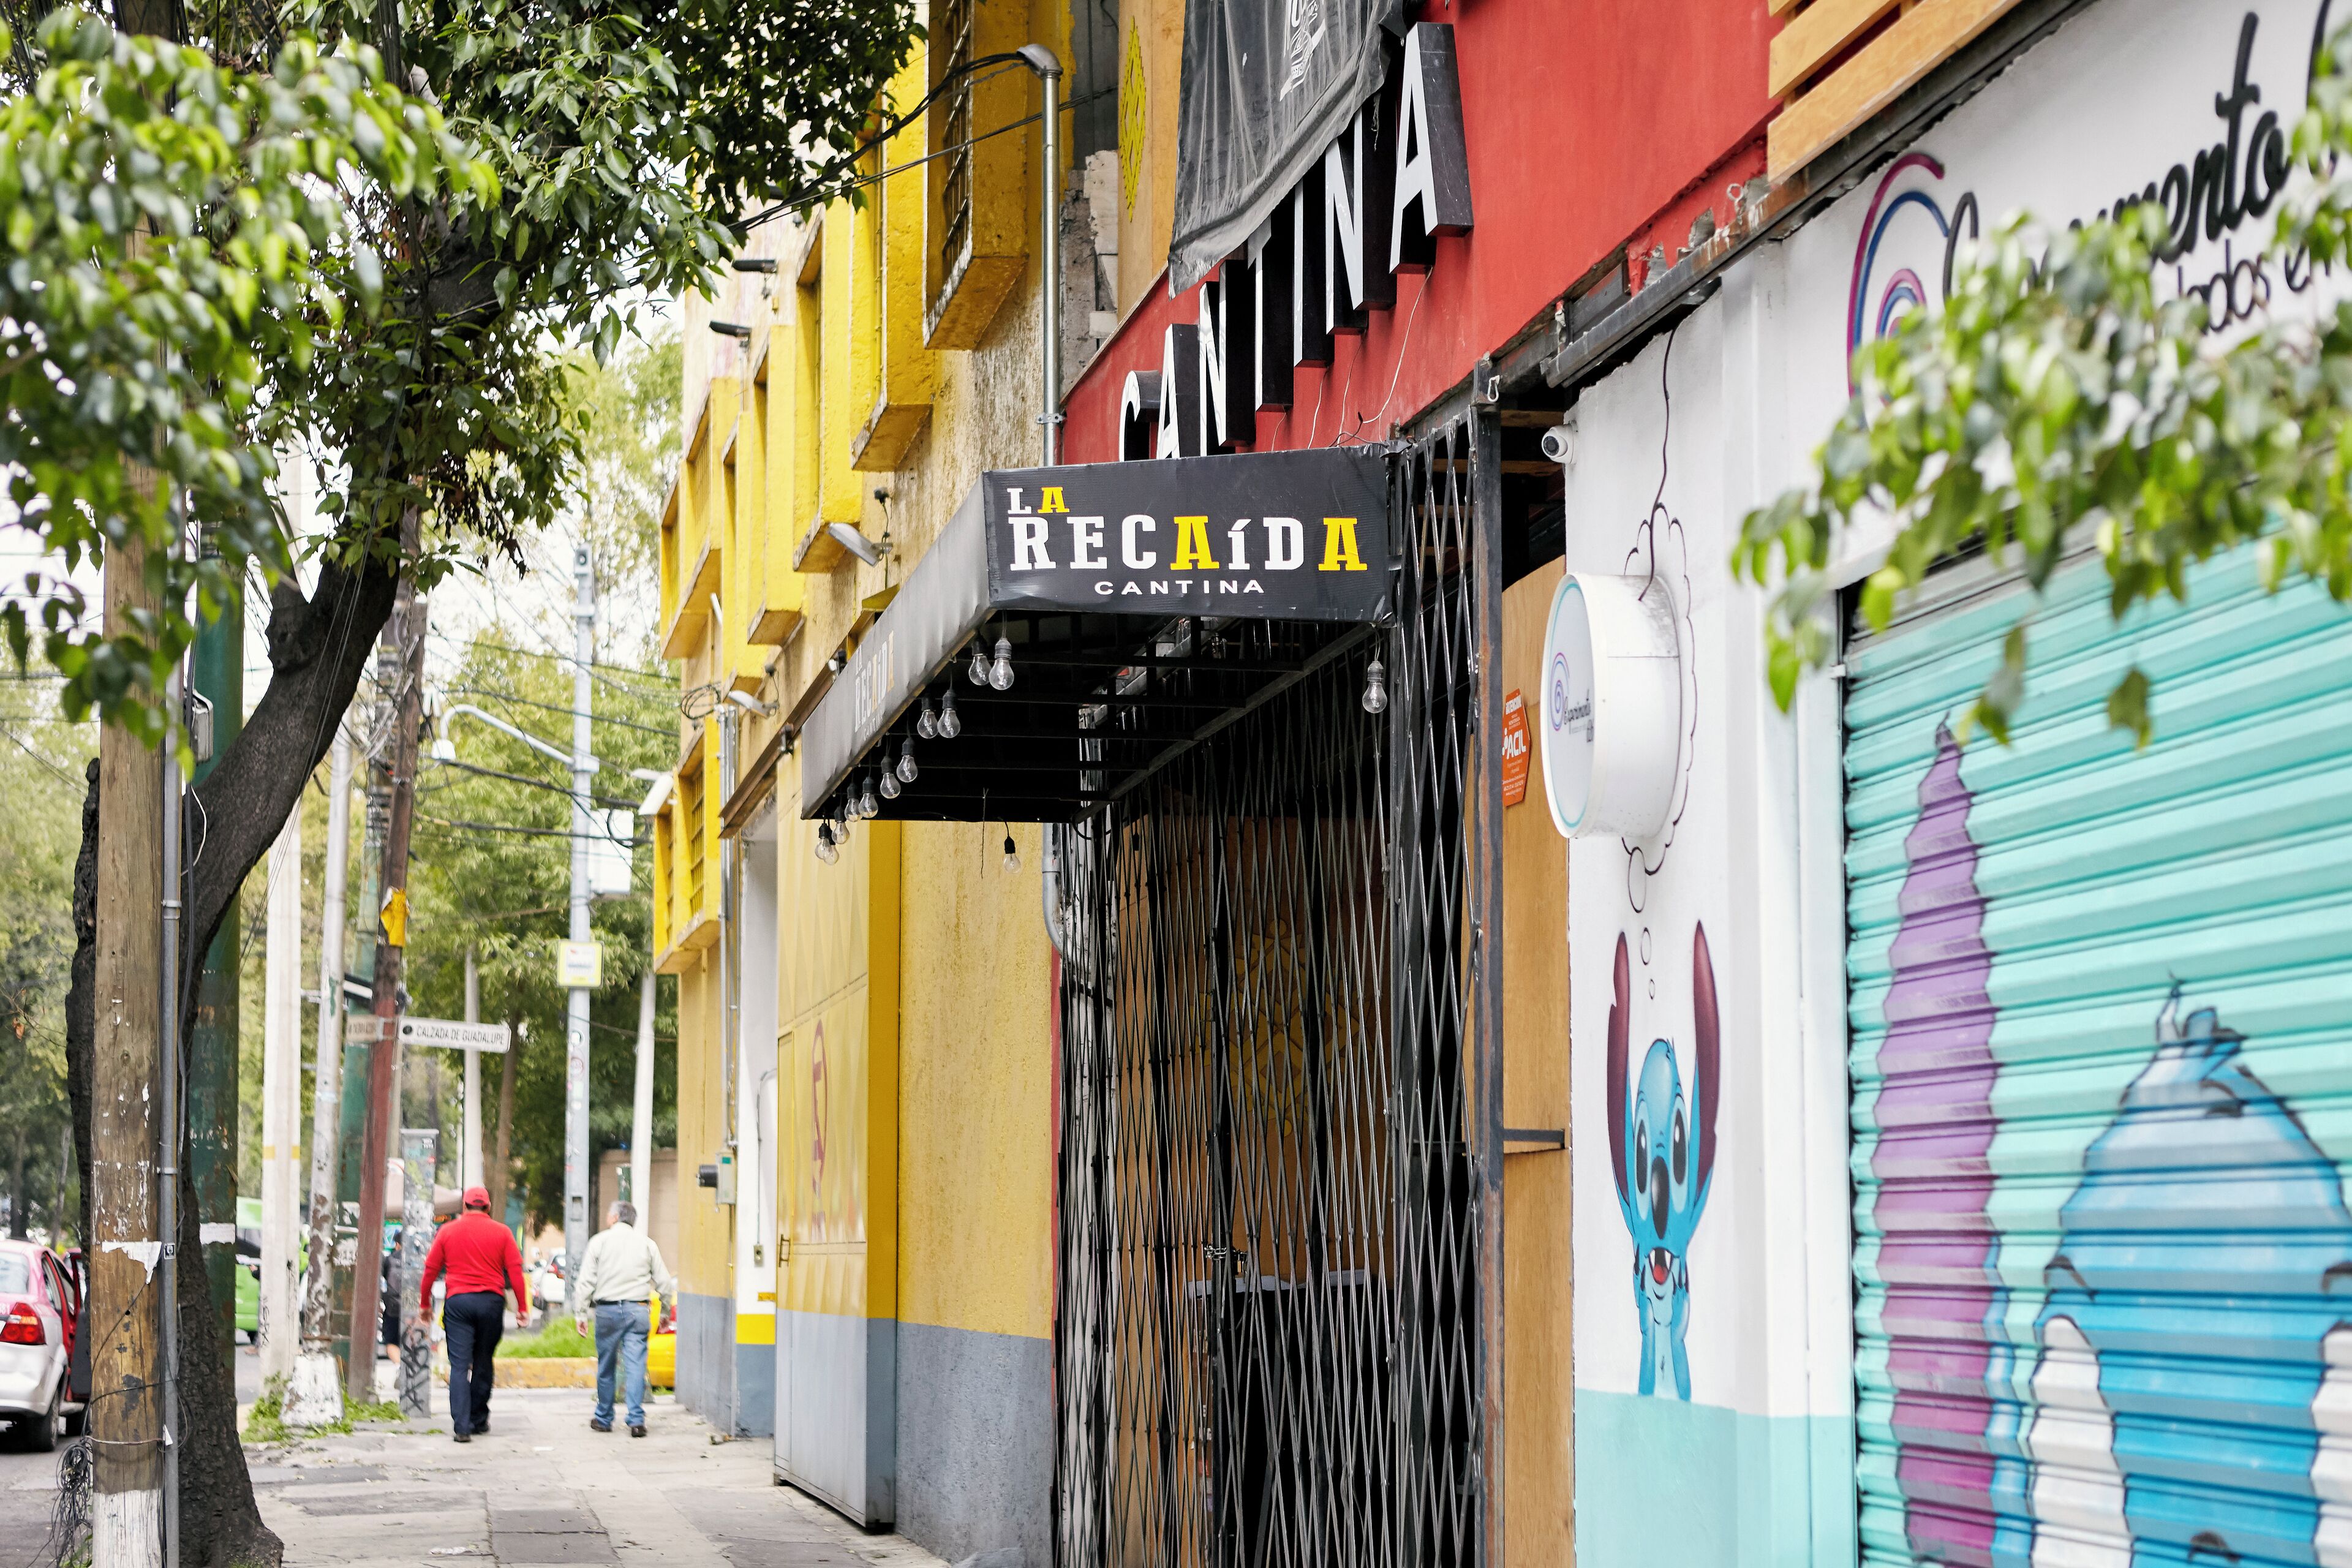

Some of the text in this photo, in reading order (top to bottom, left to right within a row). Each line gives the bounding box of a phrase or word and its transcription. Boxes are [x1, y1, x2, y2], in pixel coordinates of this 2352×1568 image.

[1007, 486, 1070, 514] LA
[1095, 579, 1265, 596] CANTINA
[417, 1025, 504, 1045] CALZADA DE GUADALUPE
